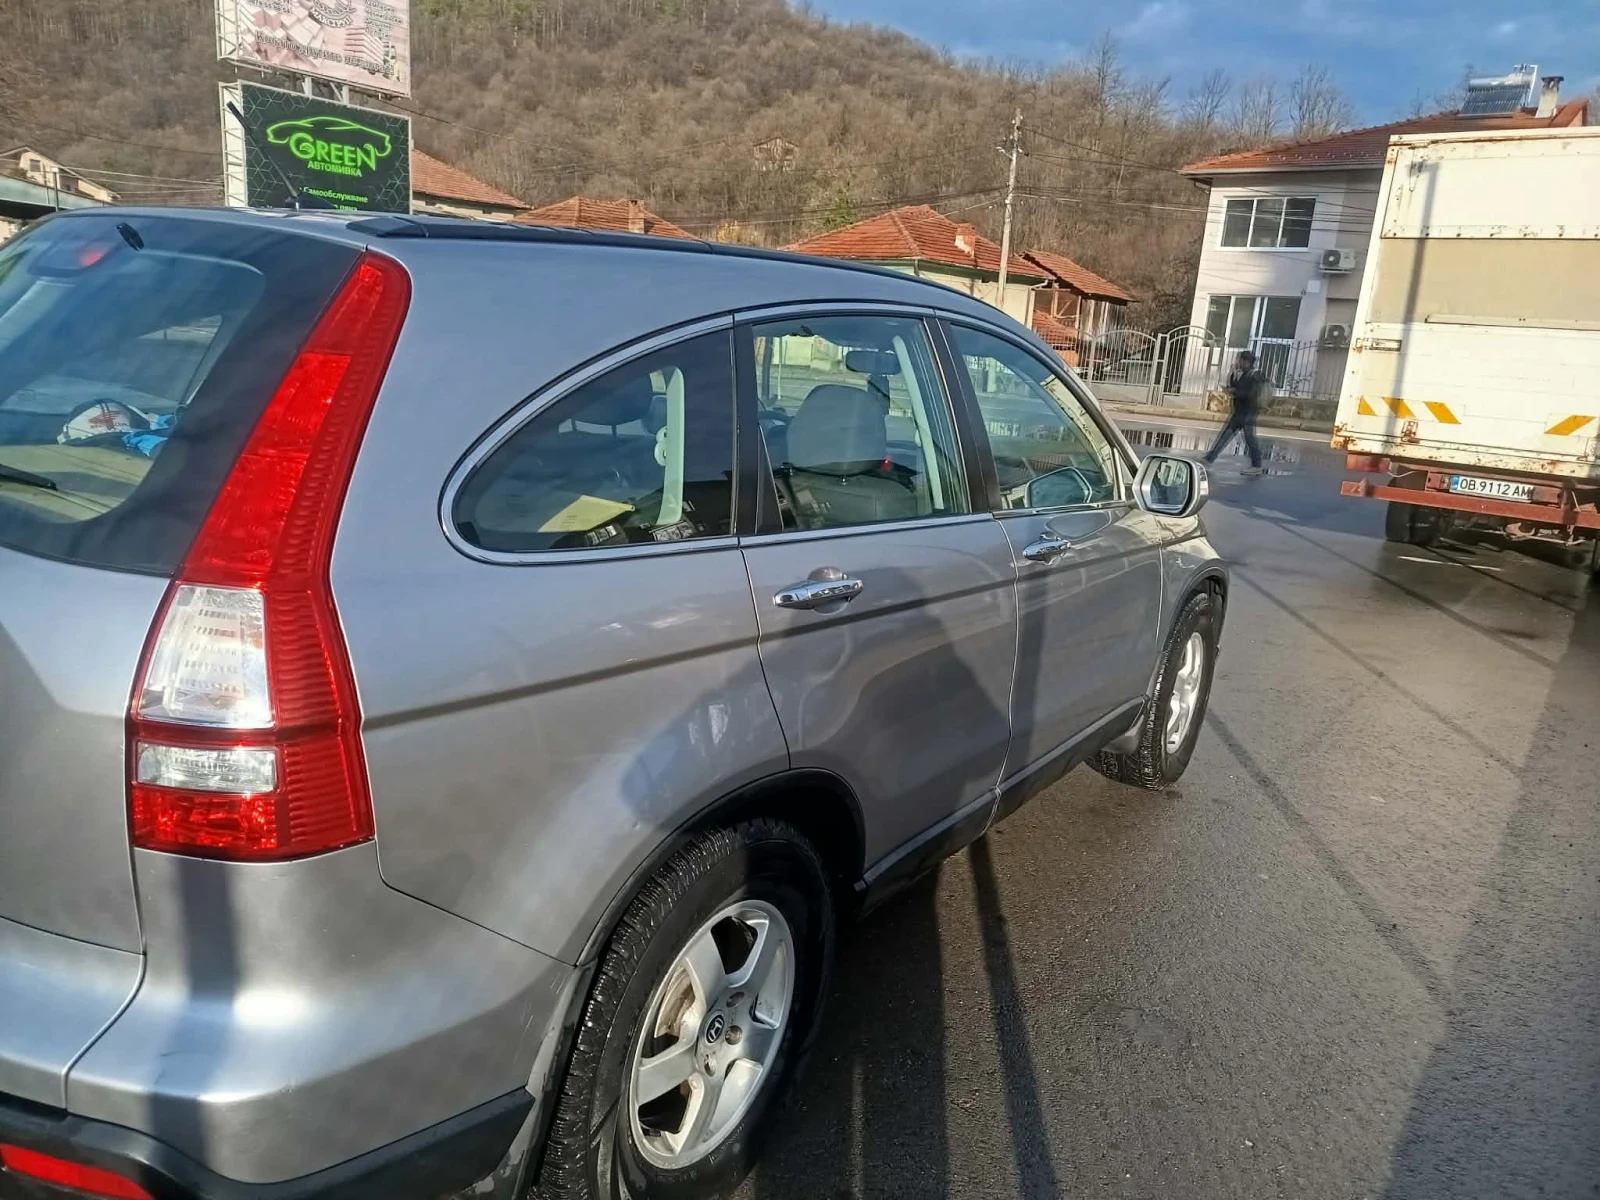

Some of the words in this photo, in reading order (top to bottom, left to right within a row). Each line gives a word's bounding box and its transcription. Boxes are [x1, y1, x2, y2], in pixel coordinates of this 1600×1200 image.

[289, 132, 376, 171] GREEN
[307, 160, 363, 177] АВТОМИВКА
[1479, 481, 1511, 495] 9112
